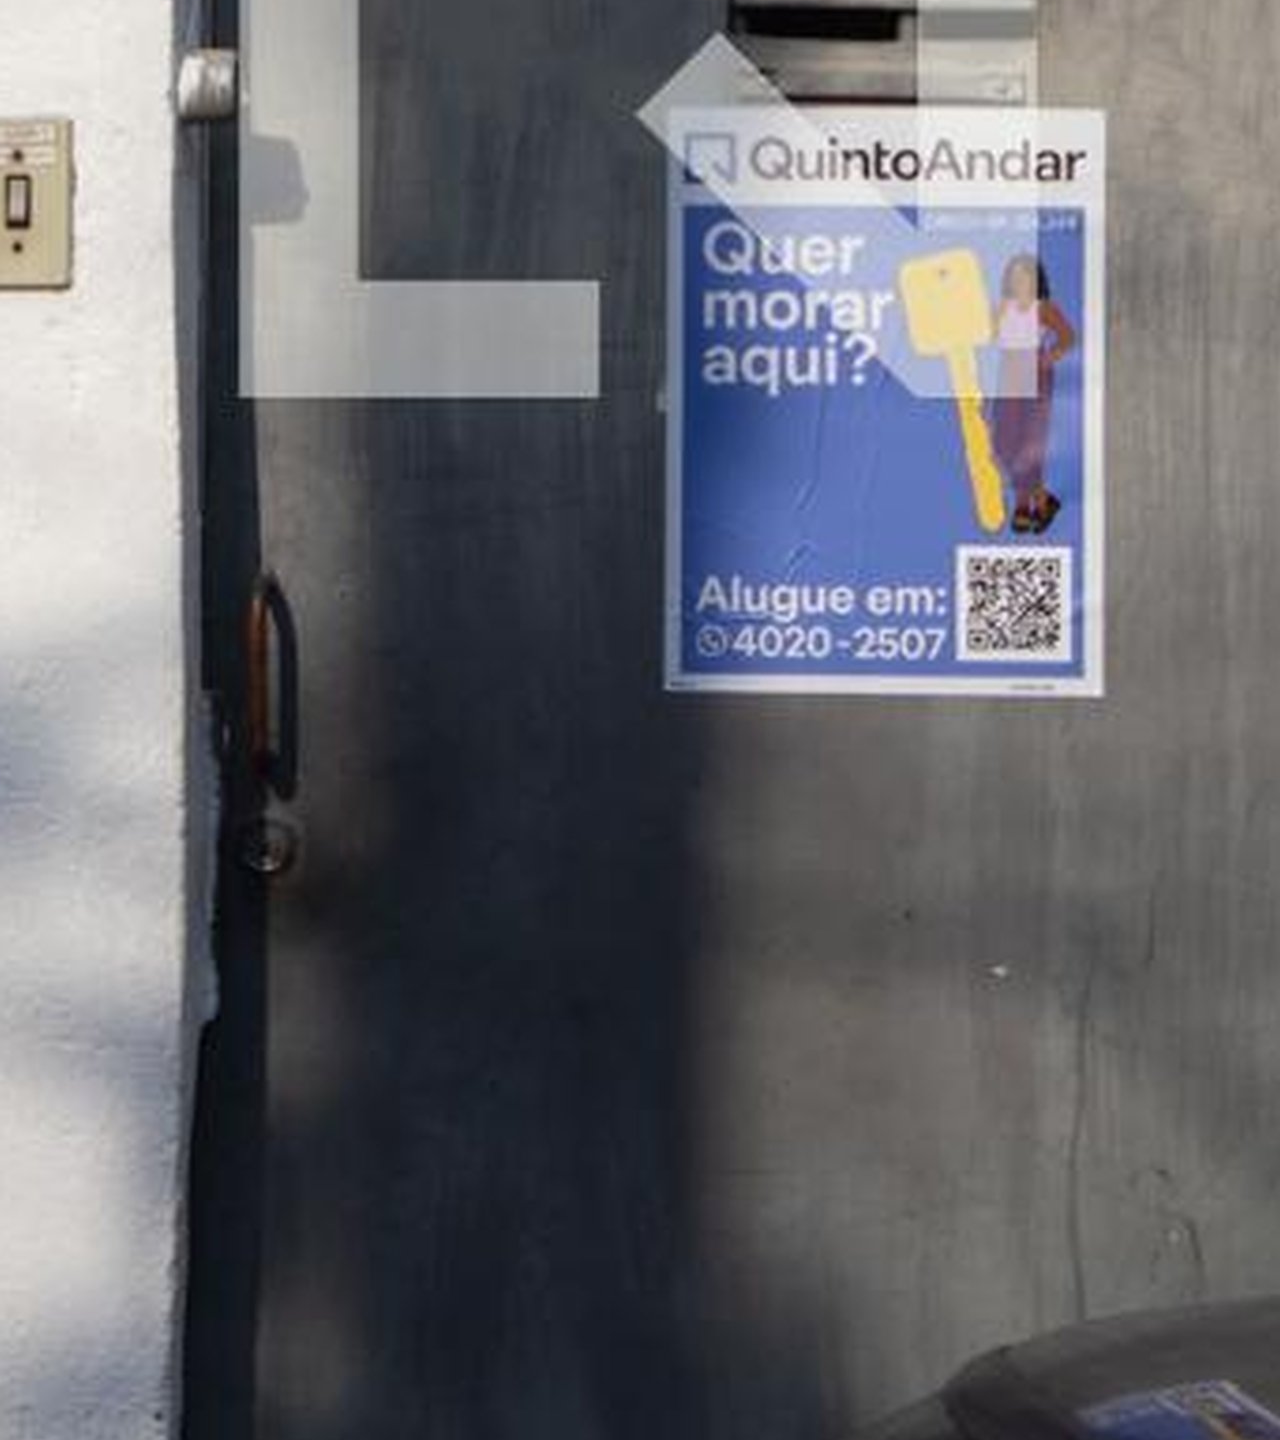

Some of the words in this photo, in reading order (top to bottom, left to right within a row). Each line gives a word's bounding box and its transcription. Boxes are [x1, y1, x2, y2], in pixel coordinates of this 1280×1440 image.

[749, 137, 1087, 183] QuintoAndar
[701, 221, 865, 276] Quer
[701, 289, 895, 331] morar
[701, 333, 878, 397] aqui?
[695, 574, 855, 623] Alugue
[866, 585, 947, 615] em:
